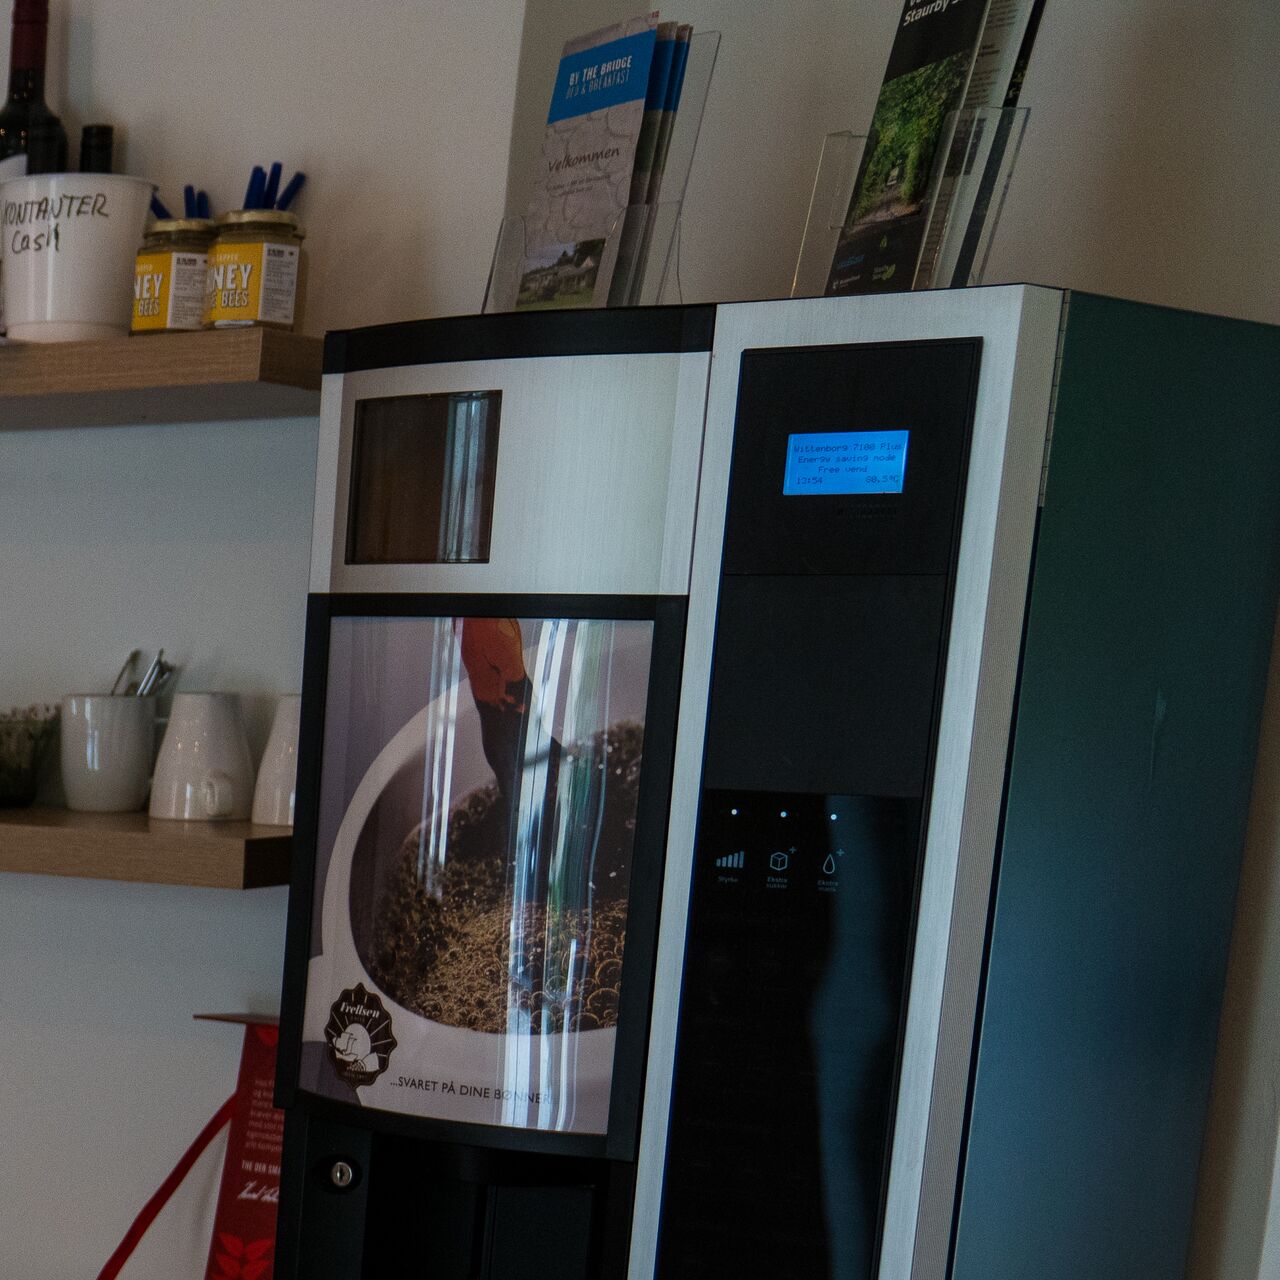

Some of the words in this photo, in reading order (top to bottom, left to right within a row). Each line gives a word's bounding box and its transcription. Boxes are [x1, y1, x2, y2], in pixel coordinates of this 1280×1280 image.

[569, 71, 580, 86] BY
[582, 65, 598, 82] THE
[600, 55, 632, 75] BRIDGE
[589, 69, 630, 92] BREAKFAST
[548, 148, 619, 172] Velkommen
[794, 444, 848, 453] Wittenborg
[798, 456, 831, 464] Energy
[836, 454, 869, 463] saving
[874, 454, 896, 462] mode
[845, 465, 868, 473] vend
[341, 1001, 380, 1018] Frellsen
[442, 1080, 456, 1094] PÅ
[460, 1085, 490, 1098] DINE
